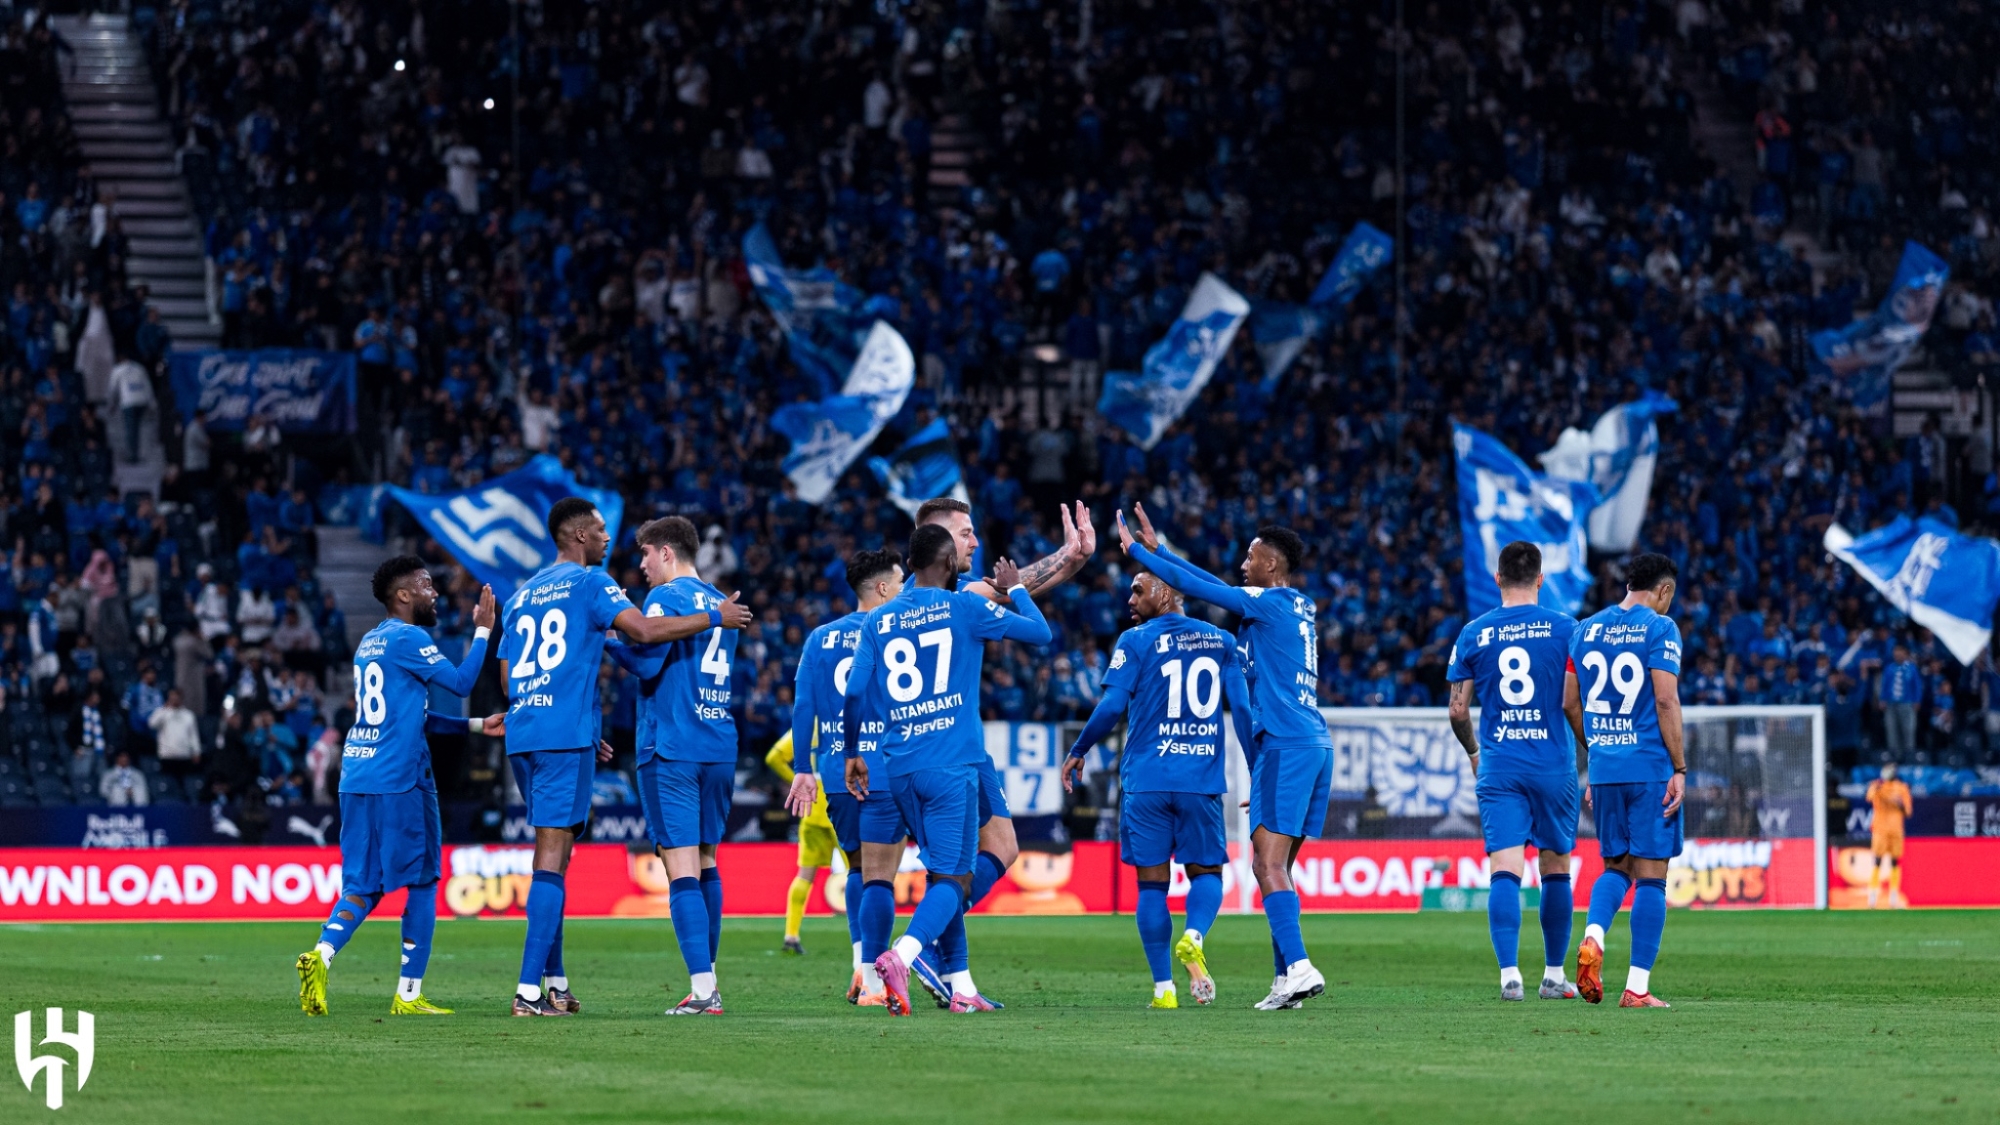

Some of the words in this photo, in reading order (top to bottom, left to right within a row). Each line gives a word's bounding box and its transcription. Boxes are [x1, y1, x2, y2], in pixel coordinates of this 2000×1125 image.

[531, 594, 551, 606] Riyad
[552, 590, 570, 601] Bank
[900, 618, 926, 629] Riyad
[927, 611, 951, 622] Bank
[511, 608, 567, 678] 28
[1499, 631, 1526, 642] Riyad
[1528, 629, 1551, 638] Bank
[1603, 634, 1625, 646] Riyad
[1626, 634, 1645, 643] Bank
[1177, 641, 1202, 651] Riyad
[1203, 640, 1224, 649] Bank
[701, 626, 730, 686] 4
[883, 627, 953, 702] 87
[1498, 646, 1535, 706] 8
[1582, 650, 1645, 714] 29
[699, 687, 731, 703] YUSUF
[1160, 656, 1220, 719] 10
[889, 692, 963, 721] ALTAMBAKTI
[1501, 709, 1541, 722] NEVES
[1592, 717, 1632, 731] SALEM
[914, 717, 955, 736] SEVEN
[1159, 723, 1218, 736] MALCOM
[1506, 728, 1548, 740] SEVEN
[1599, 733, 1638, 746] SEVEN
[343, 746, 377, 758] SEVEN
[1170, 742, 1215, 756] SEVEN
[0, 864, 217, 906] WNLOAD
[232, 864, 342, 905] NOW
[1666, 866, 1766, 907] GUYS
[446, 874, 532, 916] GUY
